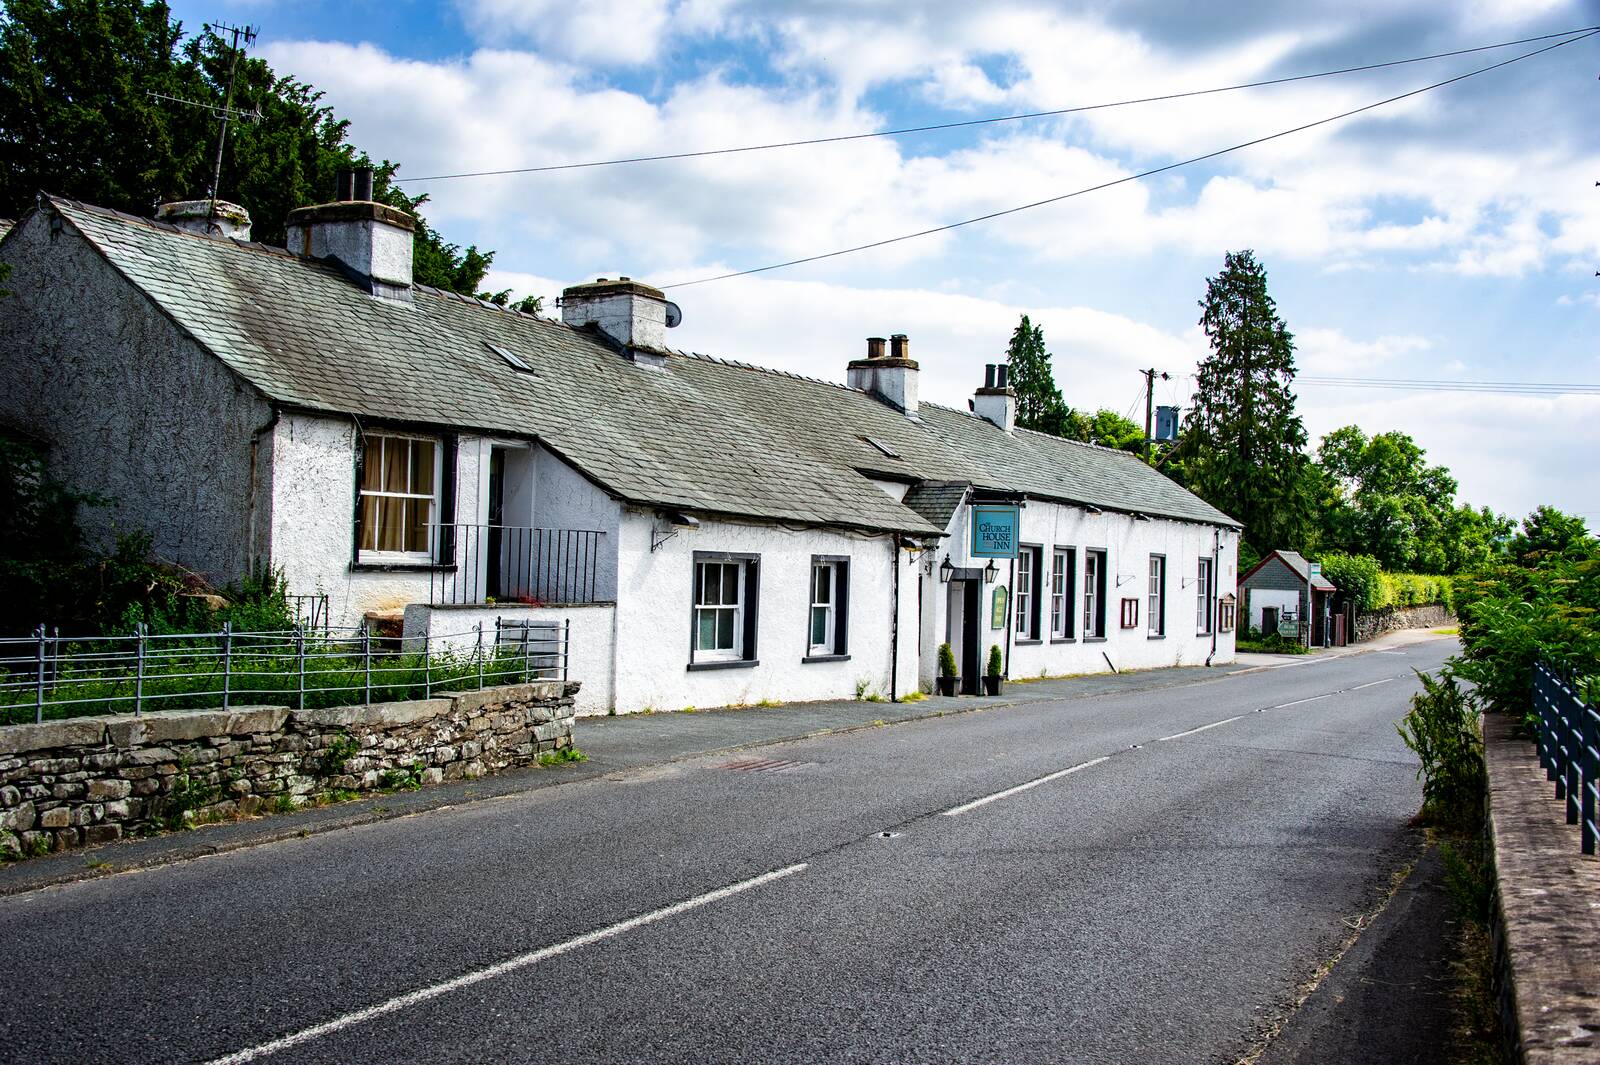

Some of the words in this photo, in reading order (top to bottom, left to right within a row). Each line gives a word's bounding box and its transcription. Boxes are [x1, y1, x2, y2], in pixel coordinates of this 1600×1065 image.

[979, 523, 1010, 533] CHURCH
[982, 532, 1010, 541] HOUSE
[993, 541, 1010, 550] INN
